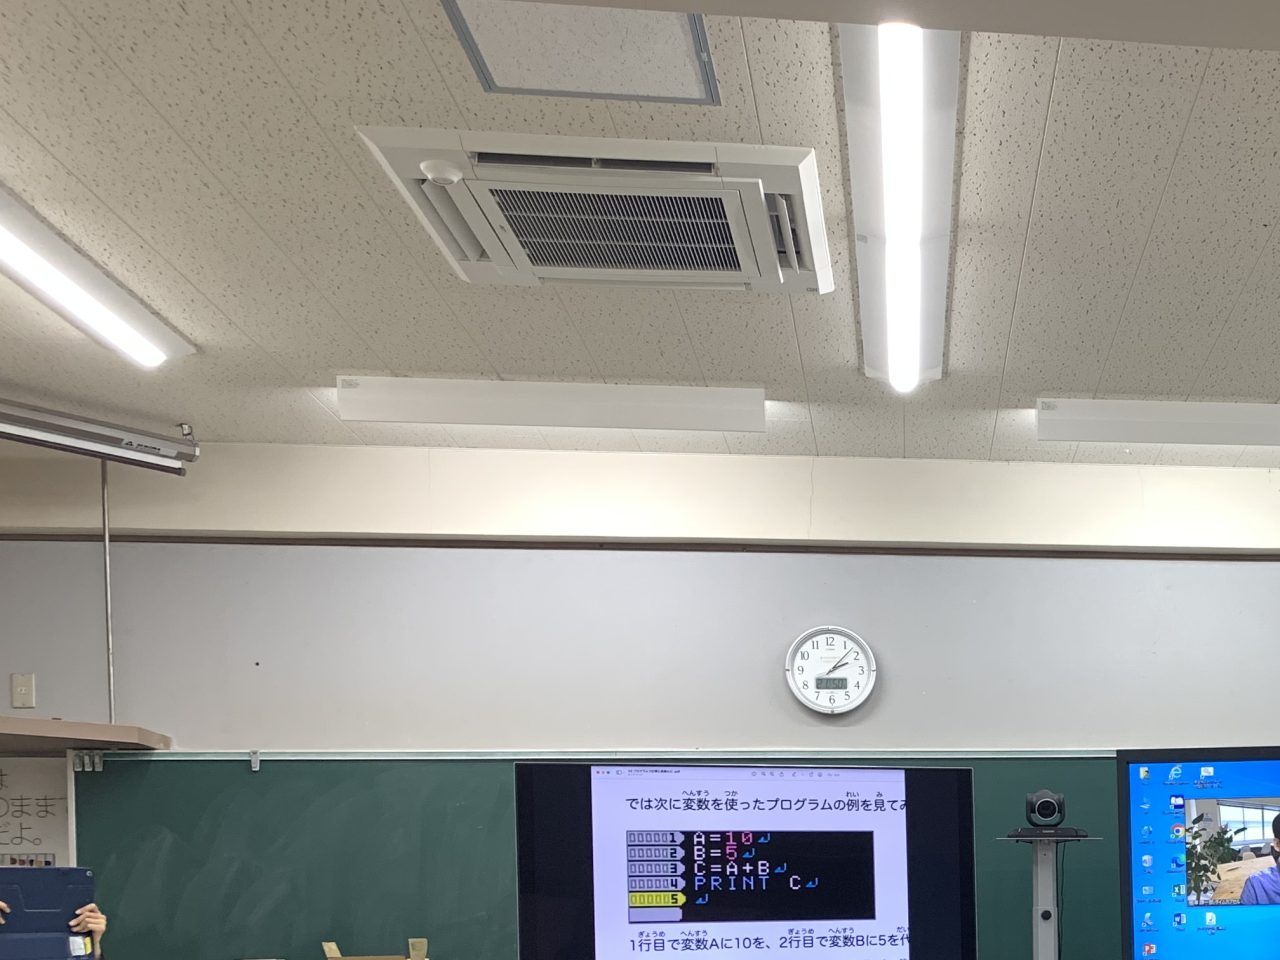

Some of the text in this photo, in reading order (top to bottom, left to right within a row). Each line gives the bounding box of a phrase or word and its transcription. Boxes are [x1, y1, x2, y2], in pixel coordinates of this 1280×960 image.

[811, 641, 819, 649] 11
[826, 637, 835, 646] 12
[800, 651, 809, 660] 10
[853, 651, 860, 660] 2
[797, 666, 804, 675] 9
[858, 666, 865, 675] 3
[802, 681, 809, 689] 8
[854, 681, 860, 690] 4
[814, 691, 820, 700] 7
[829, 695, 835, 704] 6
[844, 691, 850, 700] 5
[629, 832, 677, 843] 000001
[629, 847, 678, 858] 000002
[629, 863, 678, 874] 000003
[630, 875, 801, 891] 000004 PRINT C
